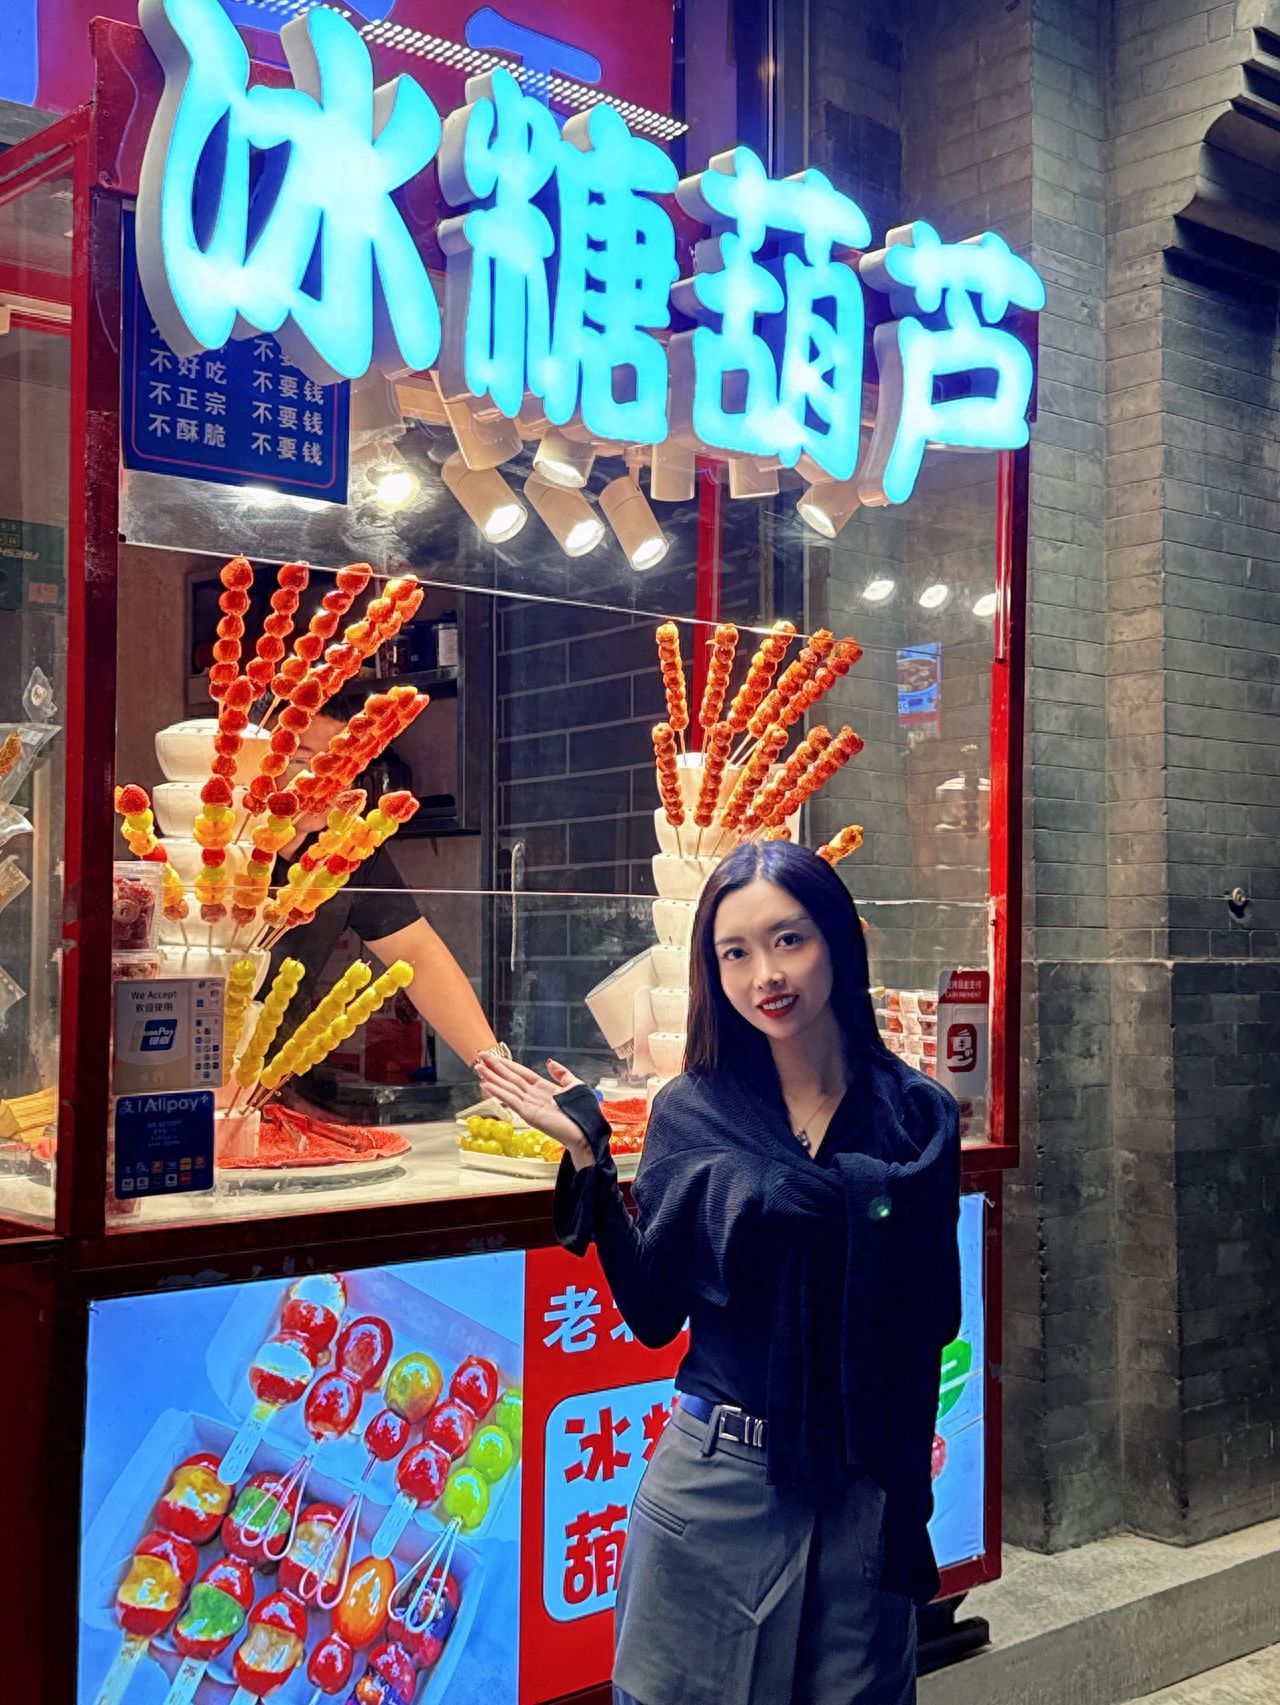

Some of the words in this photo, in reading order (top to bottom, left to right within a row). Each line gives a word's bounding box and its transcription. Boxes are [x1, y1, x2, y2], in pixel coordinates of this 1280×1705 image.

[146, 0, 1046, 504] 冰糖葫芦
[150, 348, 228, 386] 不好吃
[252, 370, 325, 406] 不要钱
[149, 381, 227, 416] 不正宗
[251, 401, 324, 436] 不要钱
[148, 413, 227, 449] 不酥脆
[250, 432, 323, 467] 不要钱
[131, 991, 146, 1000] We
[147, 990, 178, 1001] Accept
[136, 1002, 173, 1013] 欢迎使用
